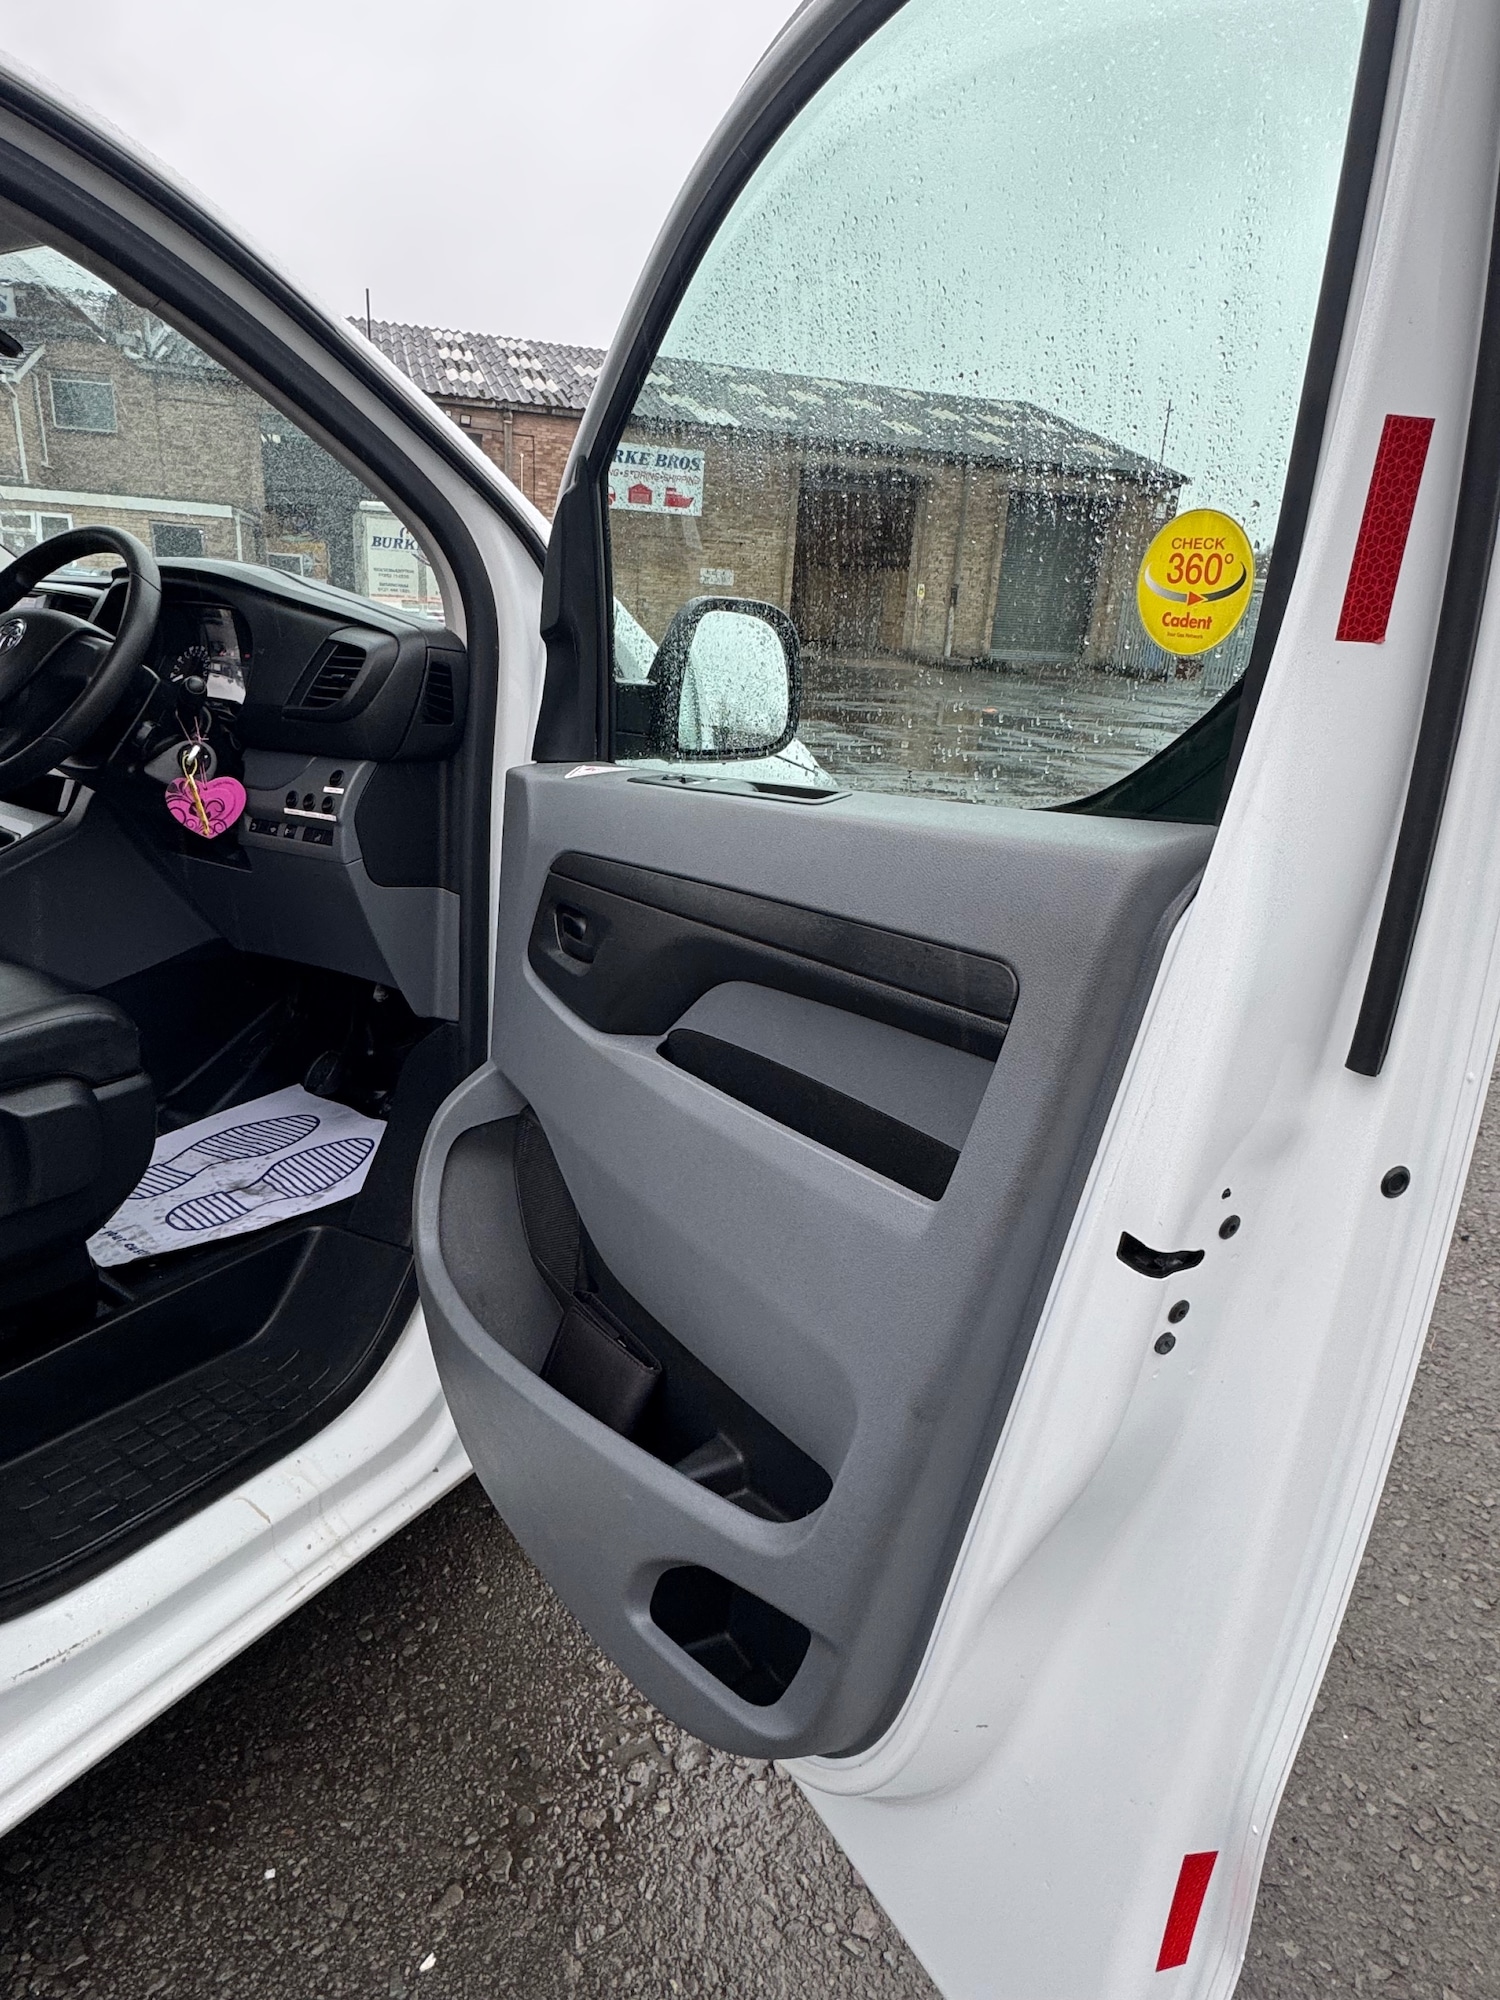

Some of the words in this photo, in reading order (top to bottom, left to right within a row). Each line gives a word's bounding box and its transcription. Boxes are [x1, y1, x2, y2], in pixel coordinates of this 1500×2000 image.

[1171, 537, 1226, 550] CHECK
[1167, 553, 1234, 586] 360°
[1162, 612, 1212, 630] Cadent
